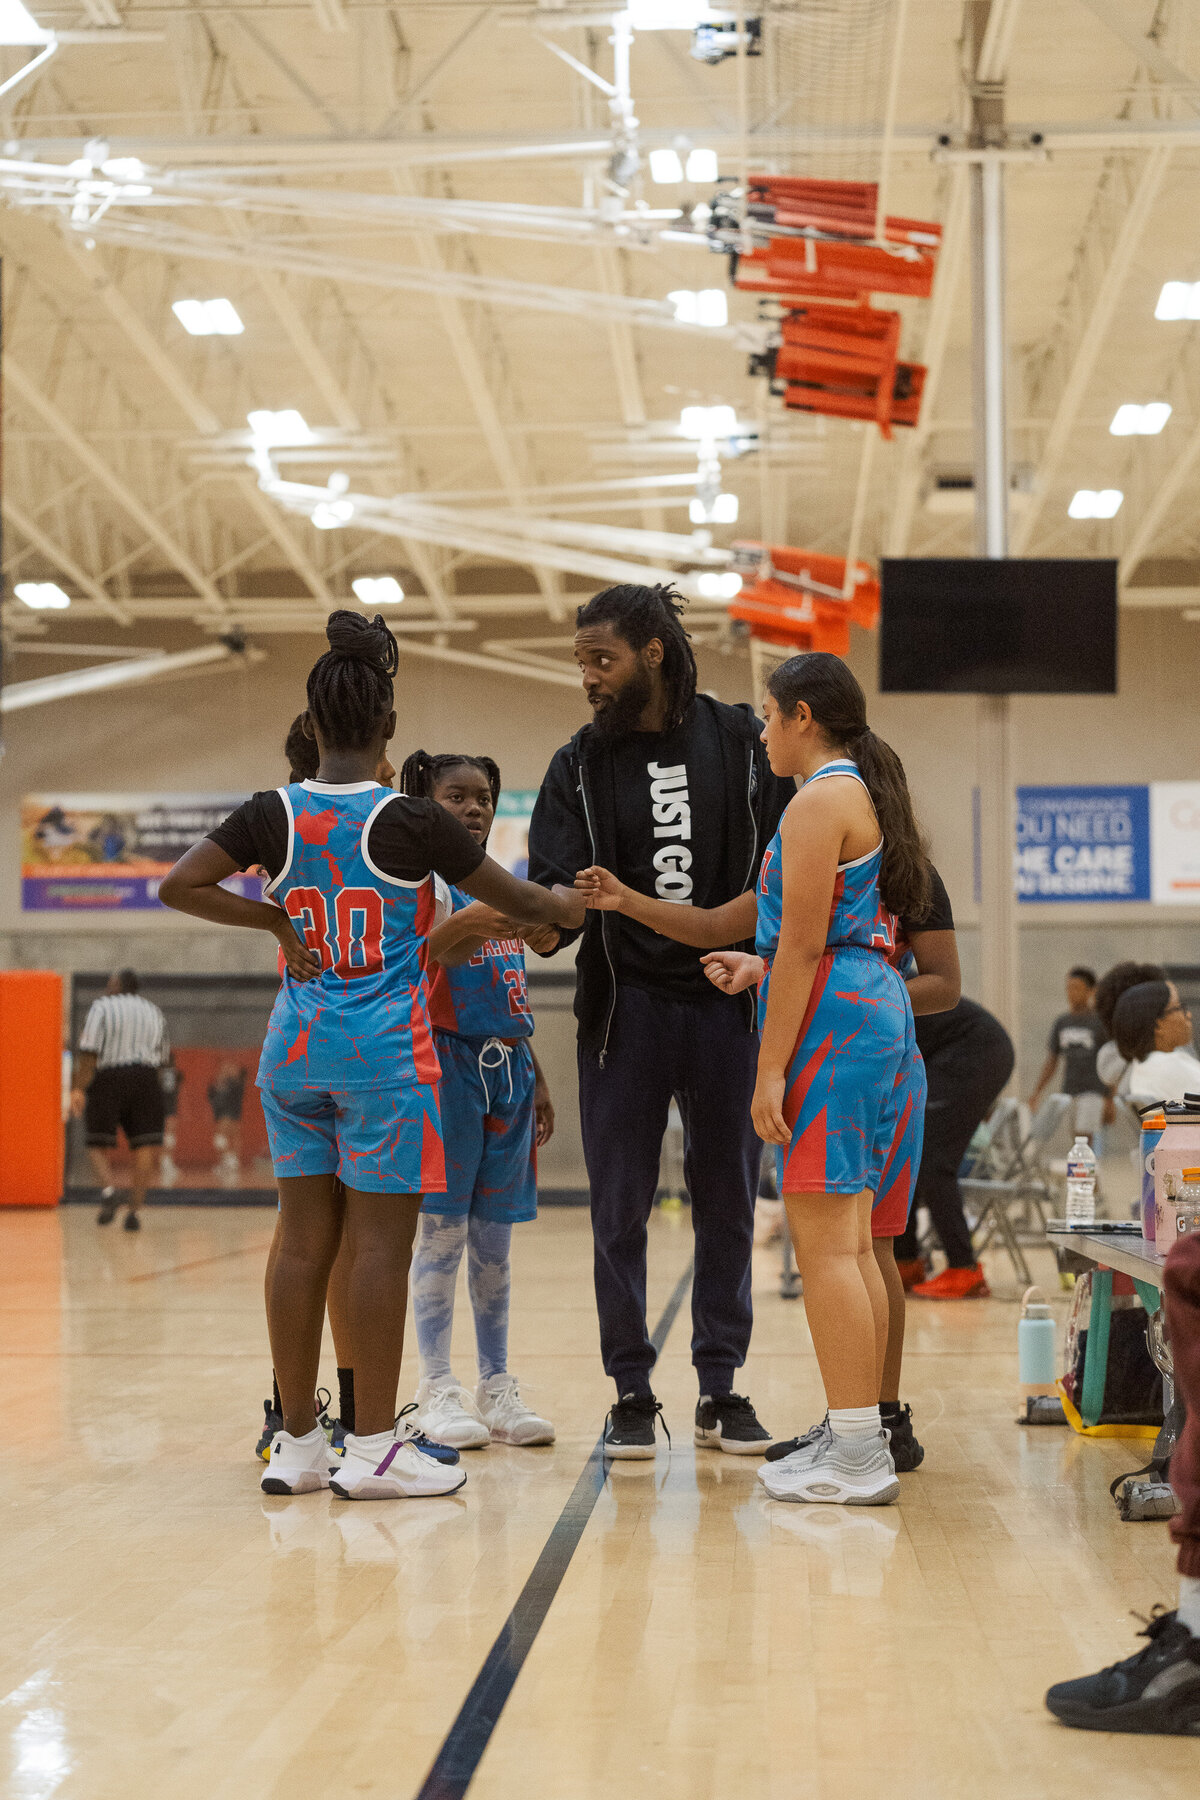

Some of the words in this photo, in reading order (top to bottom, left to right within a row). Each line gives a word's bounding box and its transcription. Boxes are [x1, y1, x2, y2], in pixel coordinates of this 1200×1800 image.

[647, 761, 690, 840] JUST
[1016, 812, 1051, 843] OU
[652, 844, 694, 907] GO
[1013, 844, 1051, 874] HE
[1054, 844, 1134, 875] CARE
[283, 886, 385, 980] 30
